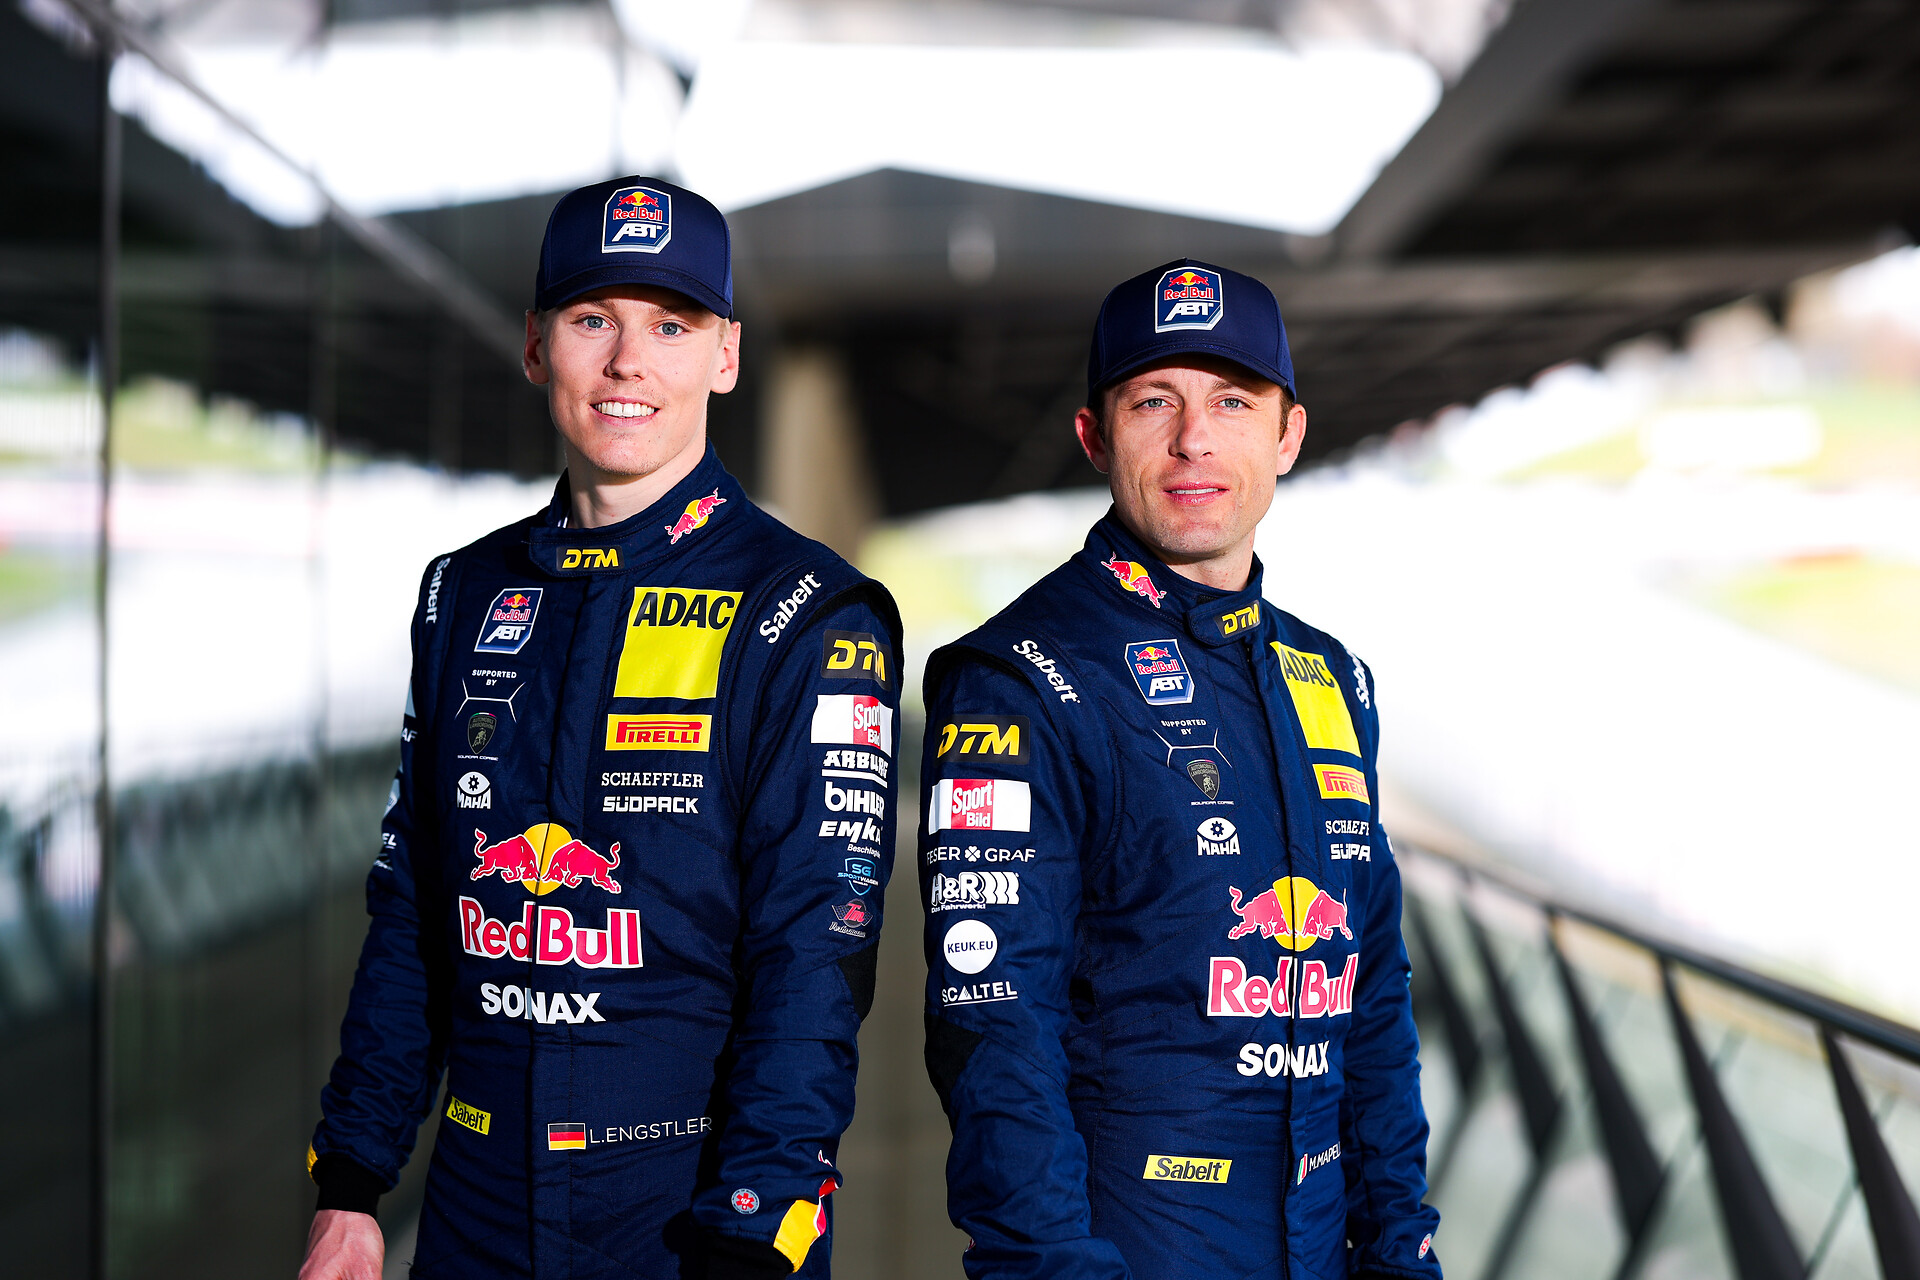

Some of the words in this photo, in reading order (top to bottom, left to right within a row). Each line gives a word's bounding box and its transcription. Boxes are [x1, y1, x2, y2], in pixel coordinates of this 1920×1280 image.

[613, 206, 637, 220] Red
[638, 206, 662, 221] Bull
[612, 223, 662, 242] ABT
[1164, 286, 1188, 300] Red
[1189, 286, 1213, 299] Bull
[1164, 302, 1214, 321] ABT
[562, 549, 619, 569] DTM
[426, 557, 451, 624] Sabelt
[492, 608, 511, 621] Red
[511, 609, 530, 622] Bull
[633, 592, 735, 630] ADAC
[759, 571, 822, 644] Sabelt
[1221, 603, 1260, 635] DTM
[484, 625, 526, 643] ABT
[826, 639, 886, 682] DTM
[1012, 639, 1080, 704] Sabelt
[1135, 661, 1159, 675] Red
[1158, 659, 1181, 673] Bull
[1280, 647, 1335, 688] ADAC
[471, 669, 517, 679] SUPPORTED
[486, 679, 497, 687] BY
[1149, 676, 1185, 697] ABT
[616, 721, 702, 743] PIRELLI
[1160, 719, 1207, 727] SUPPORTED
[1181, 728, 1192, 736] BY
[937, 723, 1020, 758] DTM
[601, 772, 704, 788] SCHAEFFLER
[1322, 770, 1367, 797] PIRELL
[457, 787, 491, 810] MAHA
[602, 796, 699, 814] SÜDPACK
[952, 781, 993, 815] Sport
[966, 811, 991, 828] Bild
[984, 847, 1036, 863] GRAF
[1197, 833, 1241, 856] MAHA
[851, 863, 872, 877] SG
[931, 871, 985, 906] H&R
[459, 895, 536, 962] Red
[536, 905, 644, 970] Bull
[947, 940, 994, 954] KEUK.EU
[942, 981, 1018, 1003] SCALTEL
[1207, 956, 1293, 1018] Red
[1299, 953, 1359, 1018] Bull
[480, 982, 607, 1025] SONAX
[1236, 1040, 1330, 1078] SONAX
[451, 1101, 487, 1132] Sabelt
[589, 1116, 713, 1144] L.ENGSTLER
[1154, 1157, 1225, 1181] Sabelt
